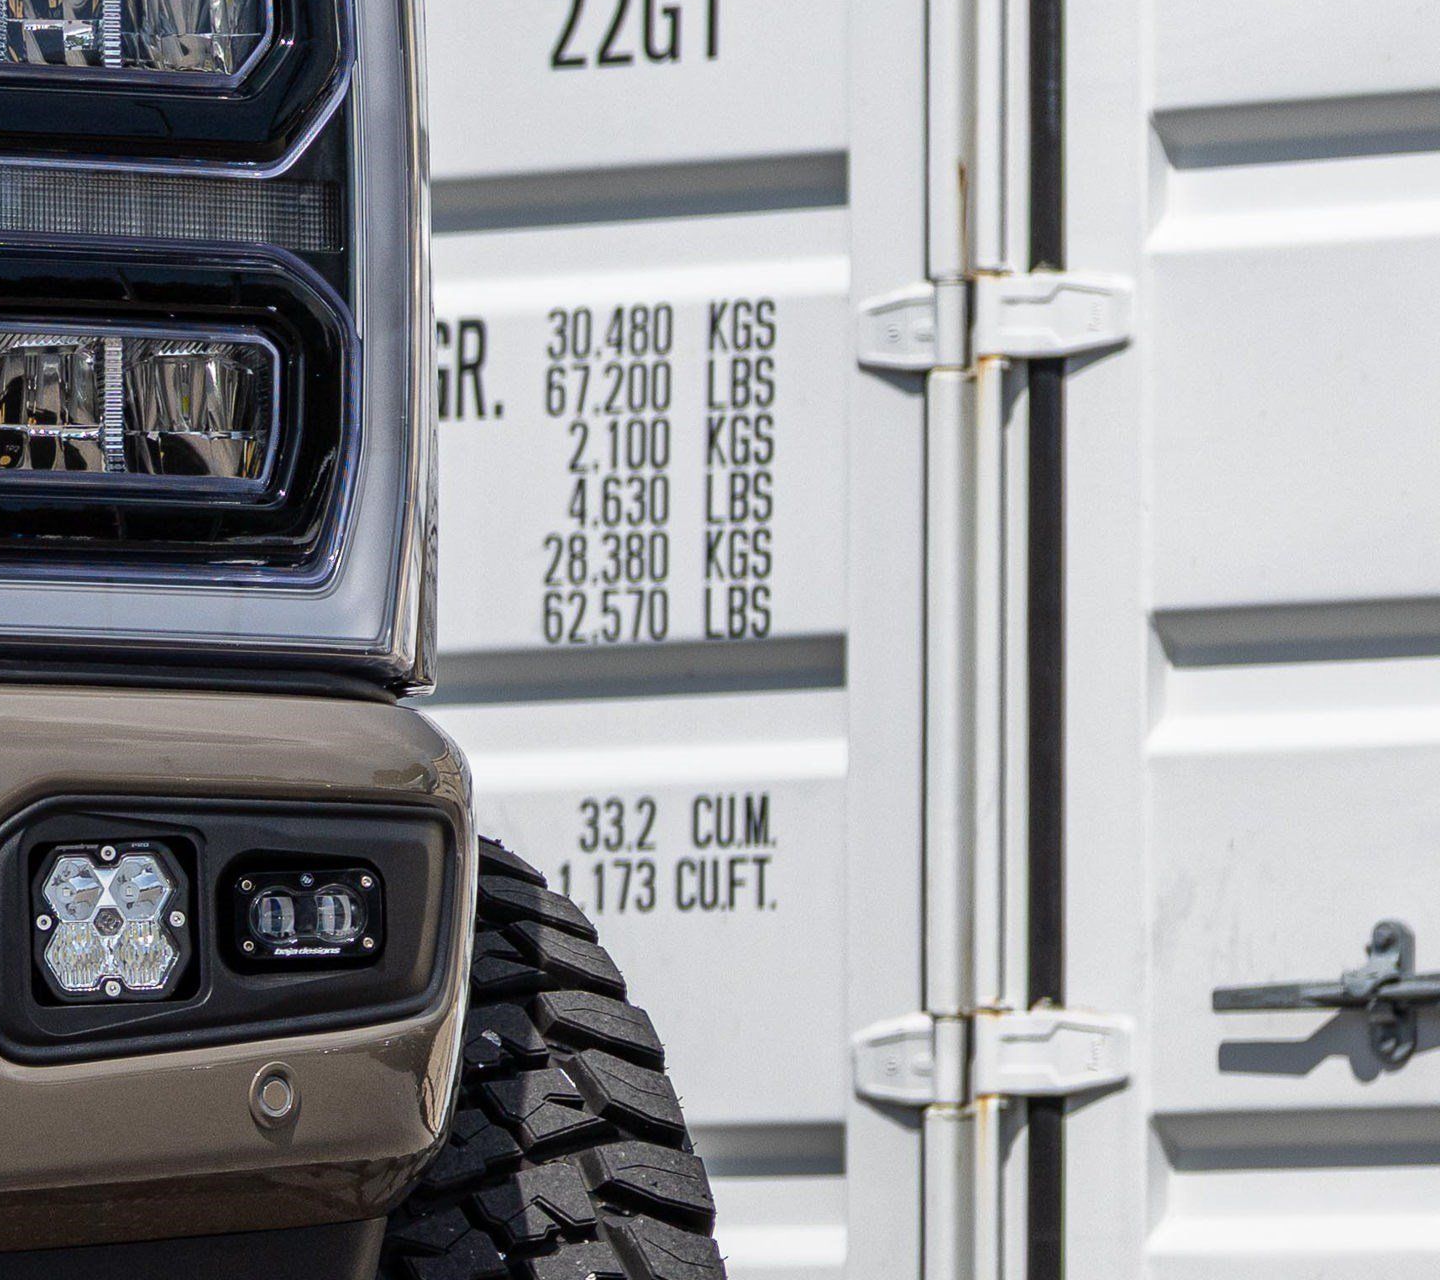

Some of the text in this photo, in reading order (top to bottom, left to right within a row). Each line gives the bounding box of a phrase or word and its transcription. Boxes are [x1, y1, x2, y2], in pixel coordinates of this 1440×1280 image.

[706, 298, 777, 354] KGS
[705, 355, 776, 412] LBS
[705, 412, 775, 470] KGS
[704, 470, 774, 525] LBS
[703, 526, 773, 582] KGS
[703, 583, 773, 640] LBS
